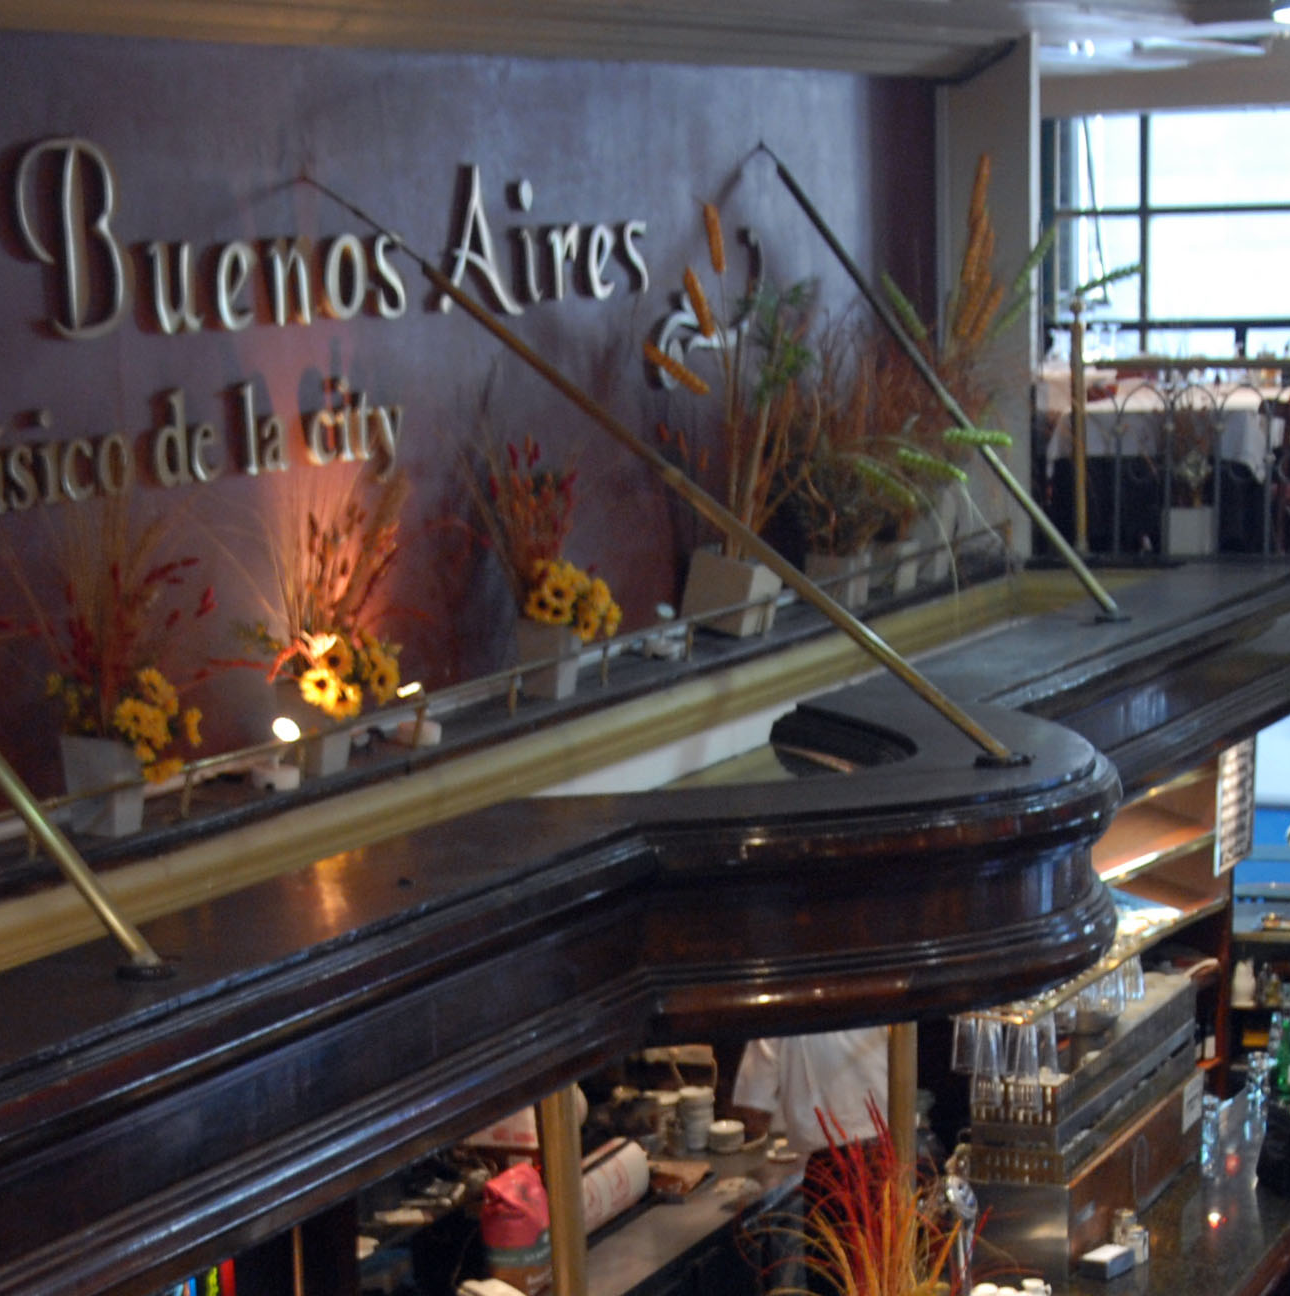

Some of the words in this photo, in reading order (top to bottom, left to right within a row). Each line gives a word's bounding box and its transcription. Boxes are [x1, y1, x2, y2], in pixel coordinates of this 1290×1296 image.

[16, 137, 408, 339] Buenos
[439, 164, 650, 315] Aires
[154, 390, 220, 487] de
[237, 382, 290, 476] la
[309, 376, 402, 482] city
